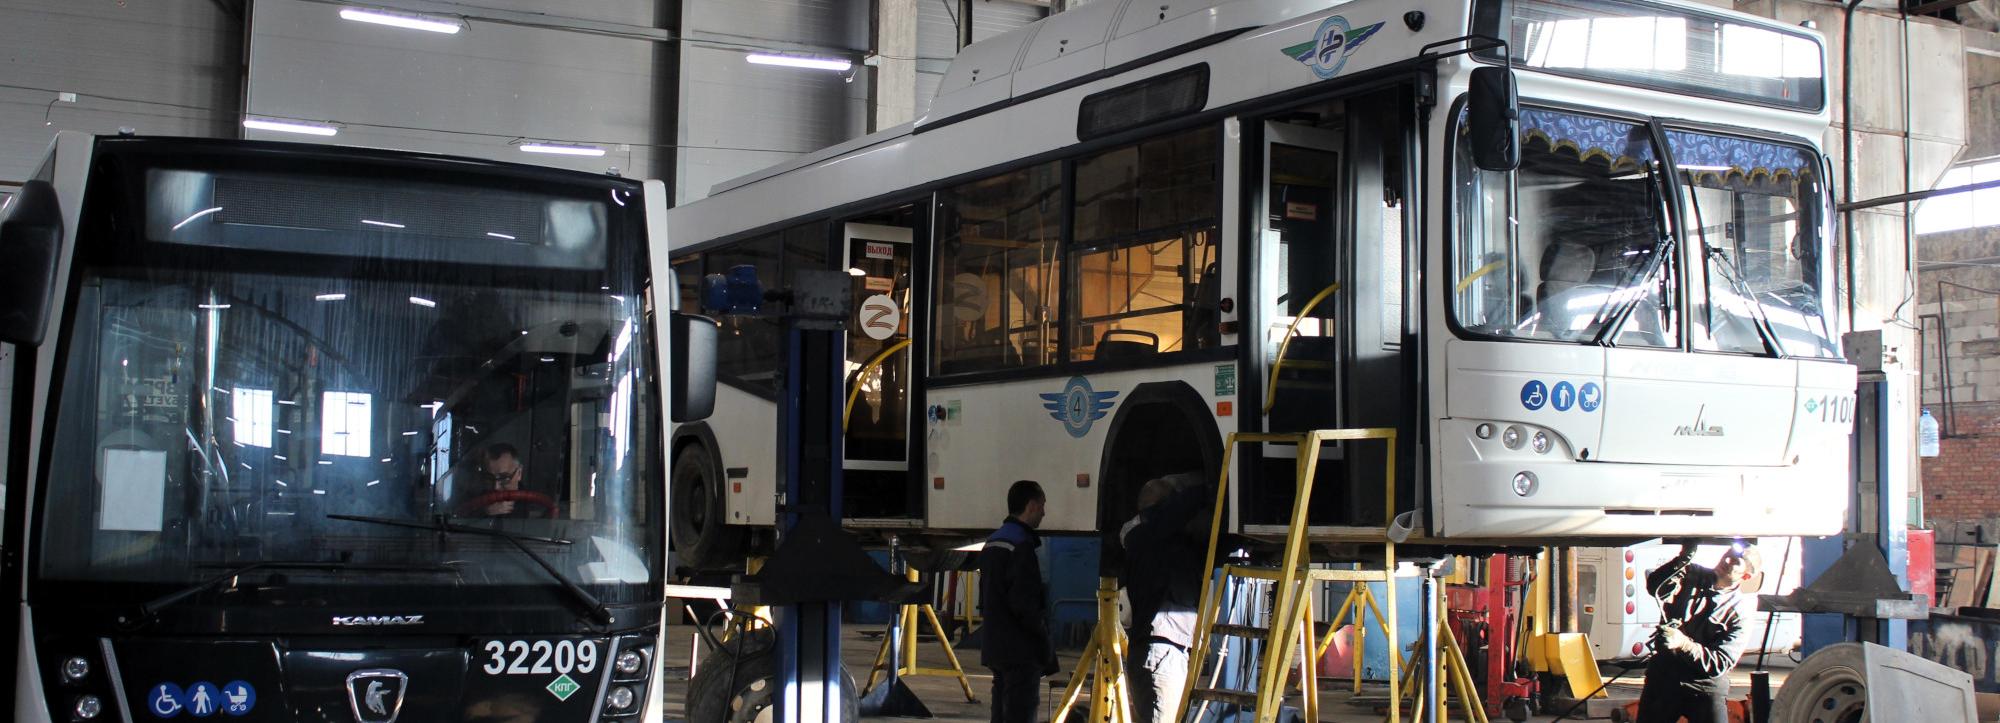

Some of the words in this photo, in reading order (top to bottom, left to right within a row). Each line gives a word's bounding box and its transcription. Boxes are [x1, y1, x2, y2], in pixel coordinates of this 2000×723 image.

[866, 245, 892, 256] ВЫХОД
[865, 304, 895, 330] Z
[1073, 396, 1082, 417] 4
[332, 614, 425, 626] KAMAZ
[483, 639, 598, 675] 32209
[554, 682, 573, 692] КПГ
